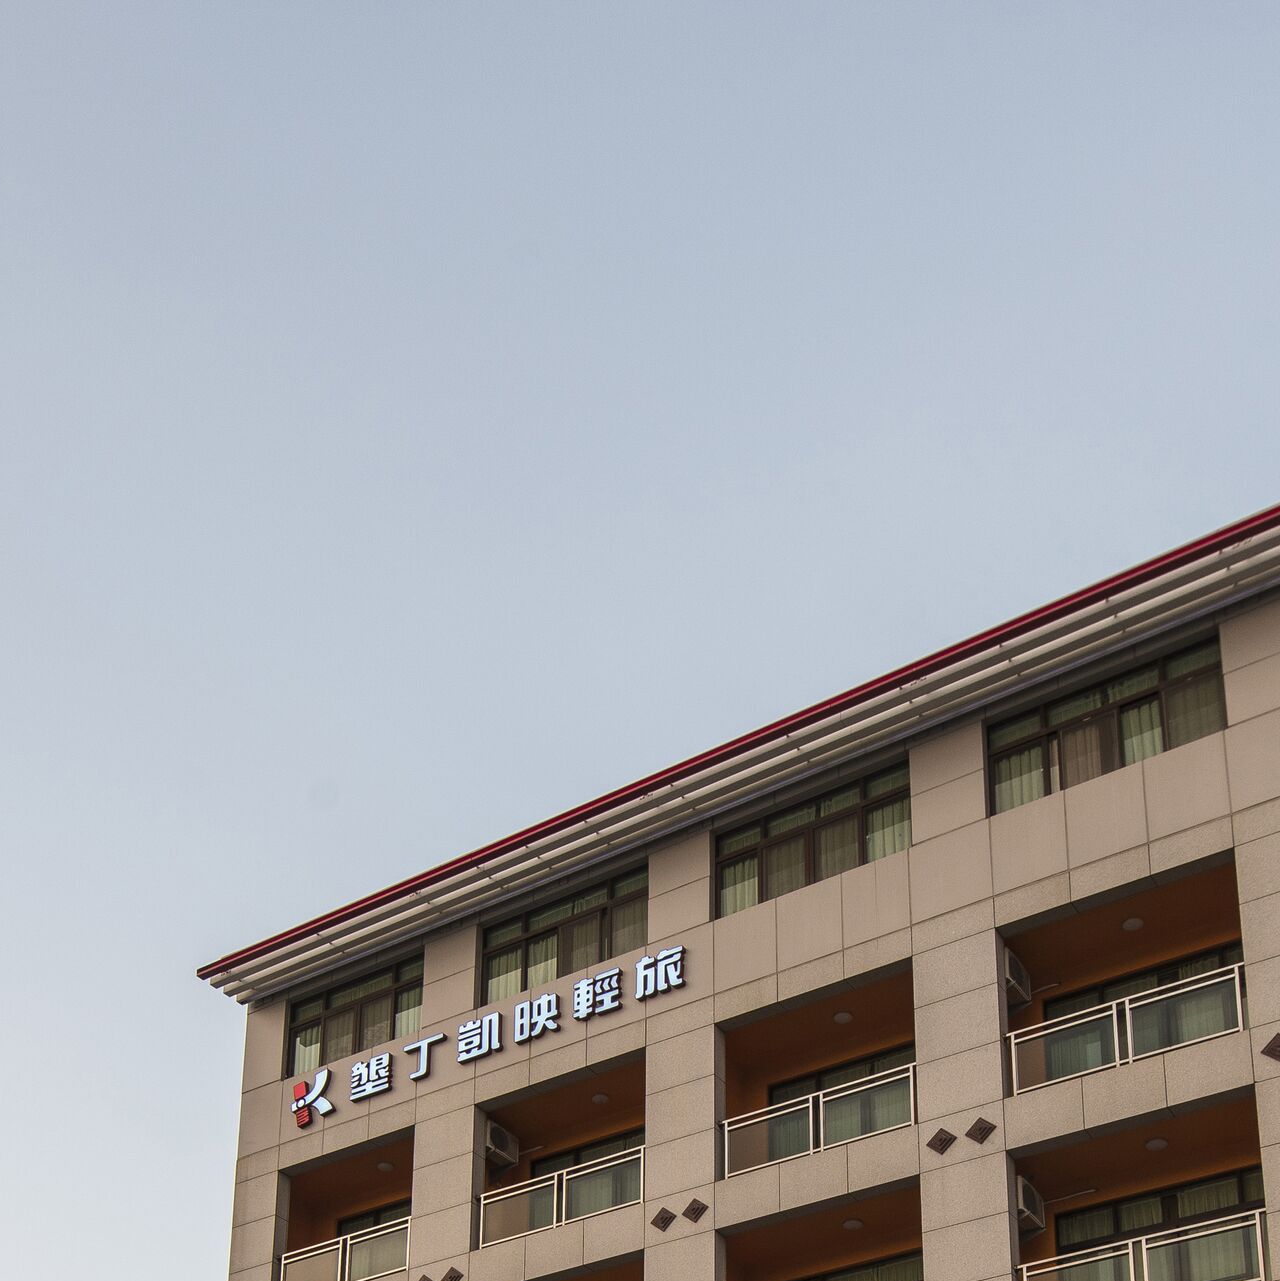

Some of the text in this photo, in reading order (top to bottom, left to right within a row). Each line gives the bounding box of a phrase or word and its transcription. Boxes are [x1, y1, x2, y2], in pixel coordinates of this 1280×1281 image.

[349, 944, 686, 1103] 墾丁凱映輕旅
